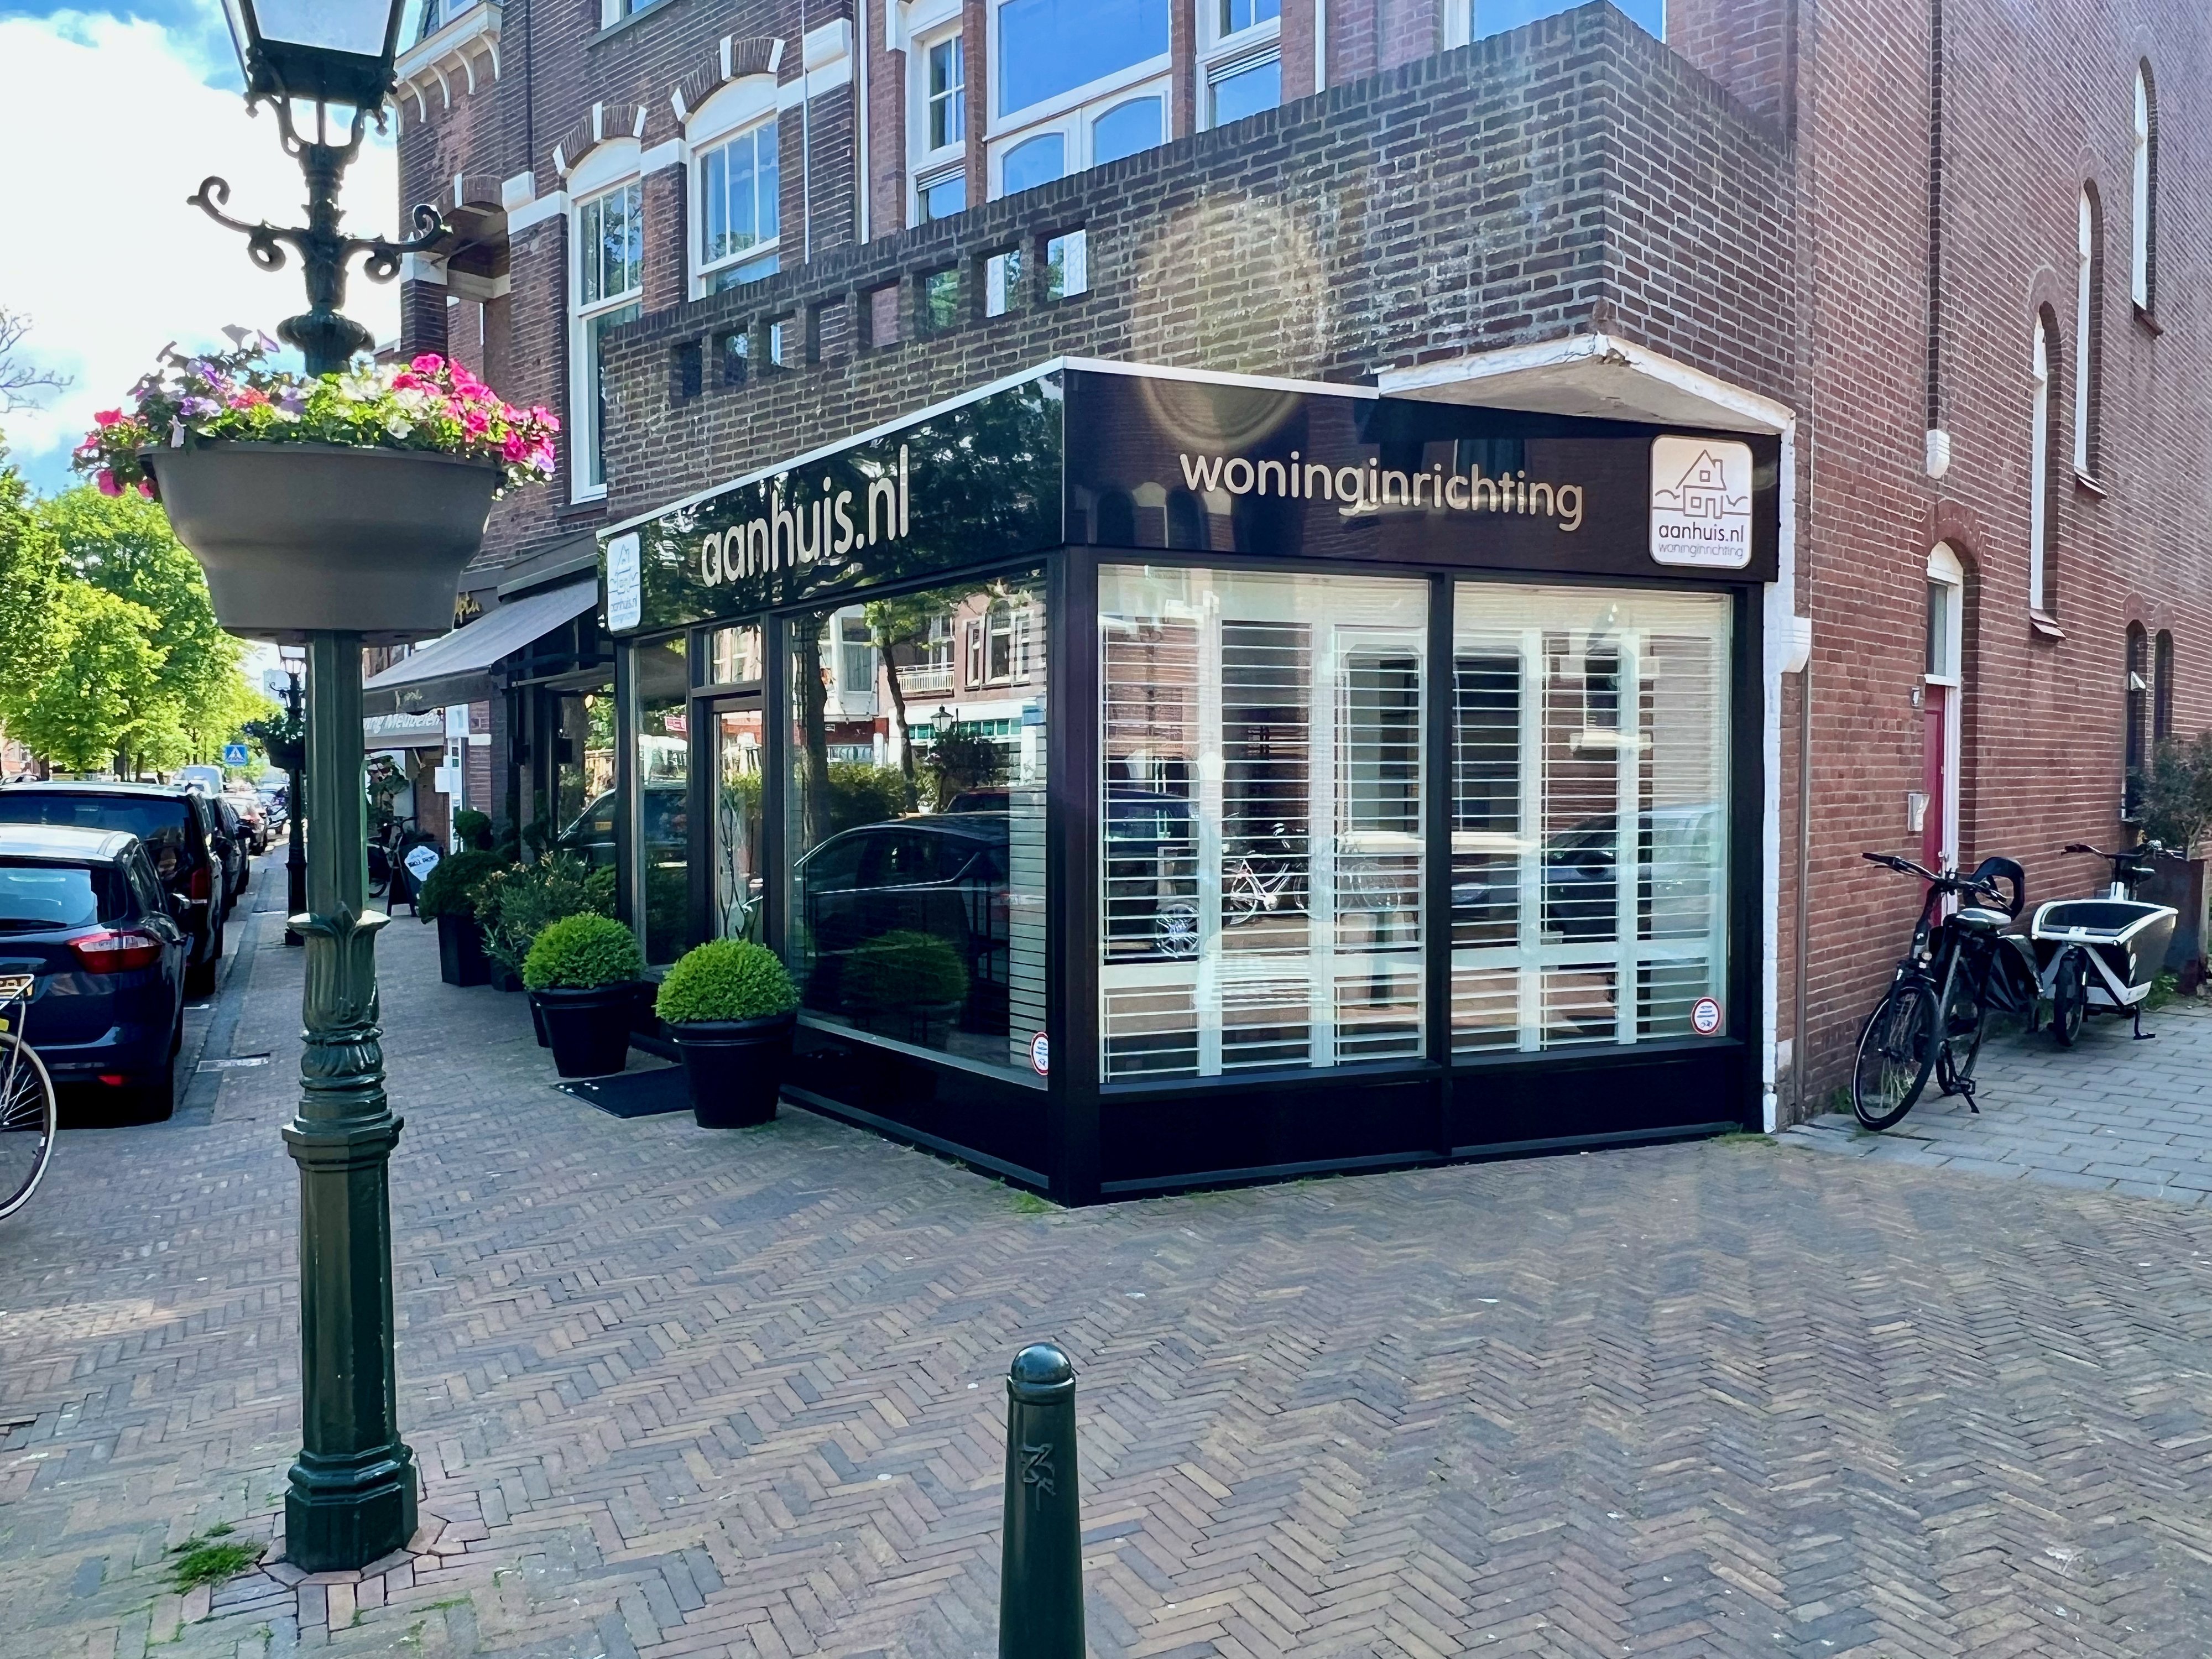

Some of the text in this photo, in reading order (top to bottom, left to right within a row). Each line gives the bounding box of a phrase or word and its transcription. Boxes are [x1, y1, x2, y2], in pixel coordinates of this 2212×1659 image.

[701, 444, 909, 587] aanhuis.nl
[1179, 451, 1583, 532] woninginrichting
[1658, 521, 1744, 542] aanhuis.nl
[1658, 544, 1744, 560] woninginrichting
